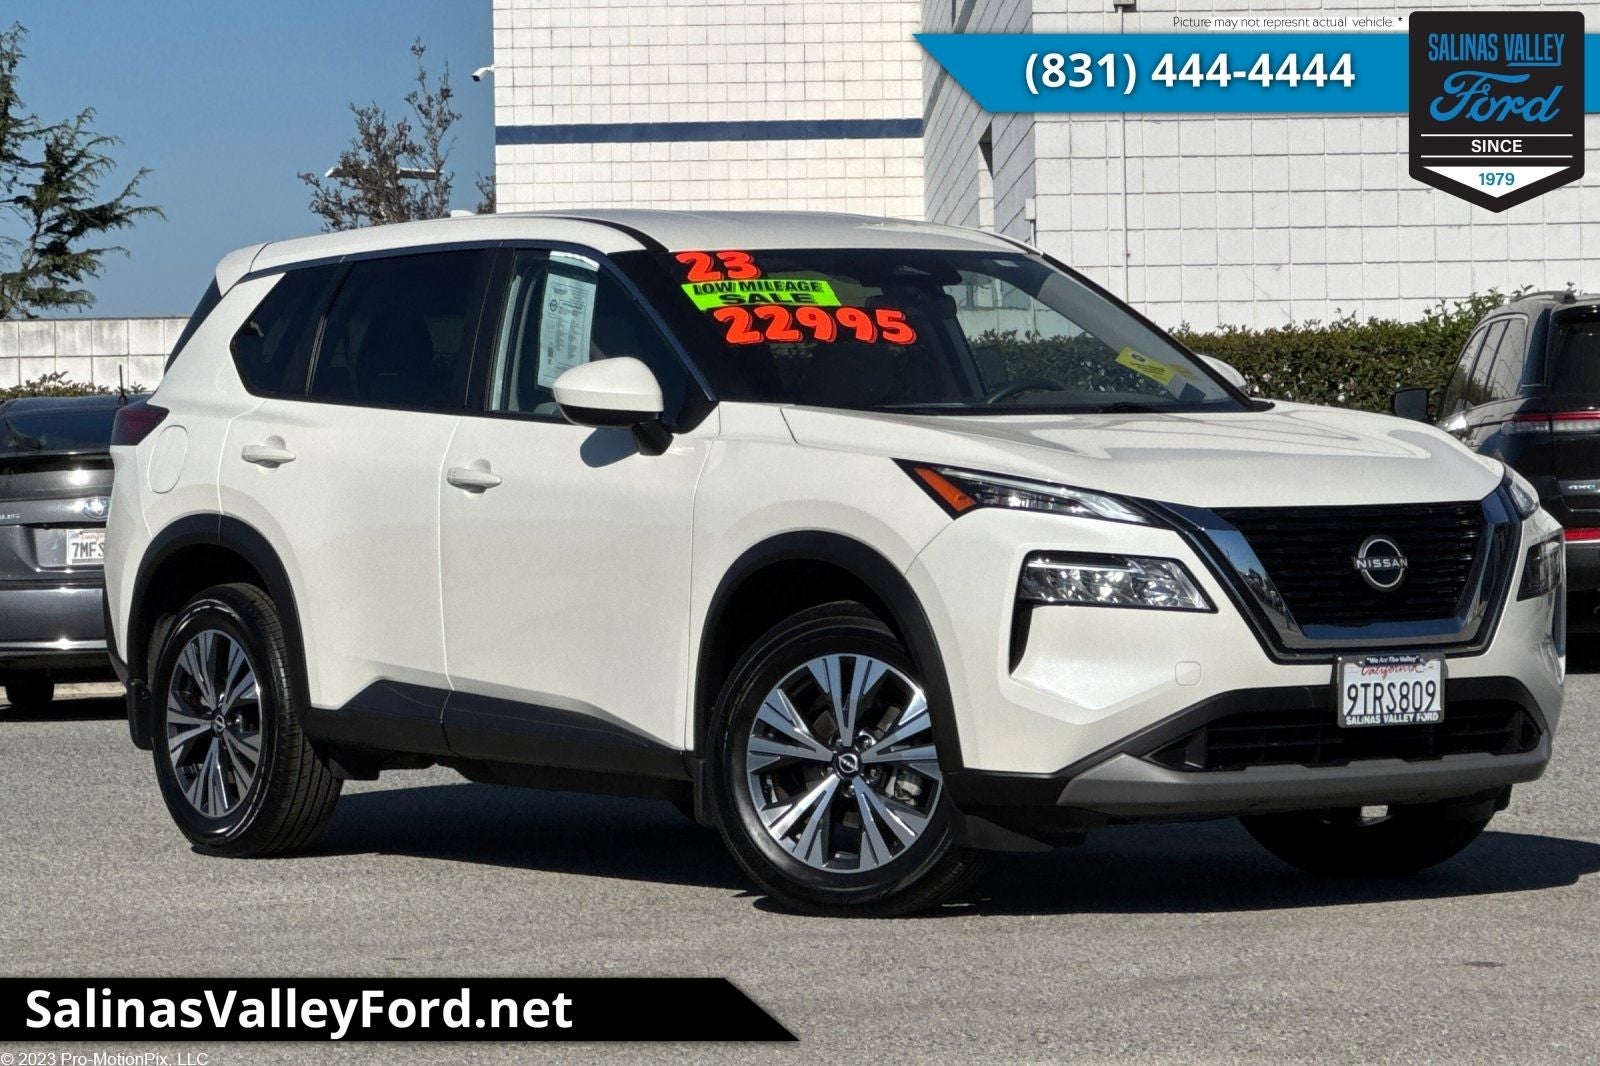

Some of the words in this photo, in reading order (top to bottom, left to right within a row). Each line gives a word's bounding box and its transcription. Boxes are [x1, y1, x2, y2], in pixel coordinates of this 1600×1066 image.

[675, 251, 762, 281] 23
[693, 283, 736, 296] LOW
[739, 281, 824, 293] MILEAGE
[719, 293, 818, 305] SALE
[713, 306, 917, 344] 22995
[1356, 559, 1408, 569] NISSAN
[1346, 680, 1436, 716] 9TRS809
[1346, 716, 1381, 725] SALINAS
[1383, 713, 1414, 723] VALLEY
[1416, 712, 1438, 721] FORD
